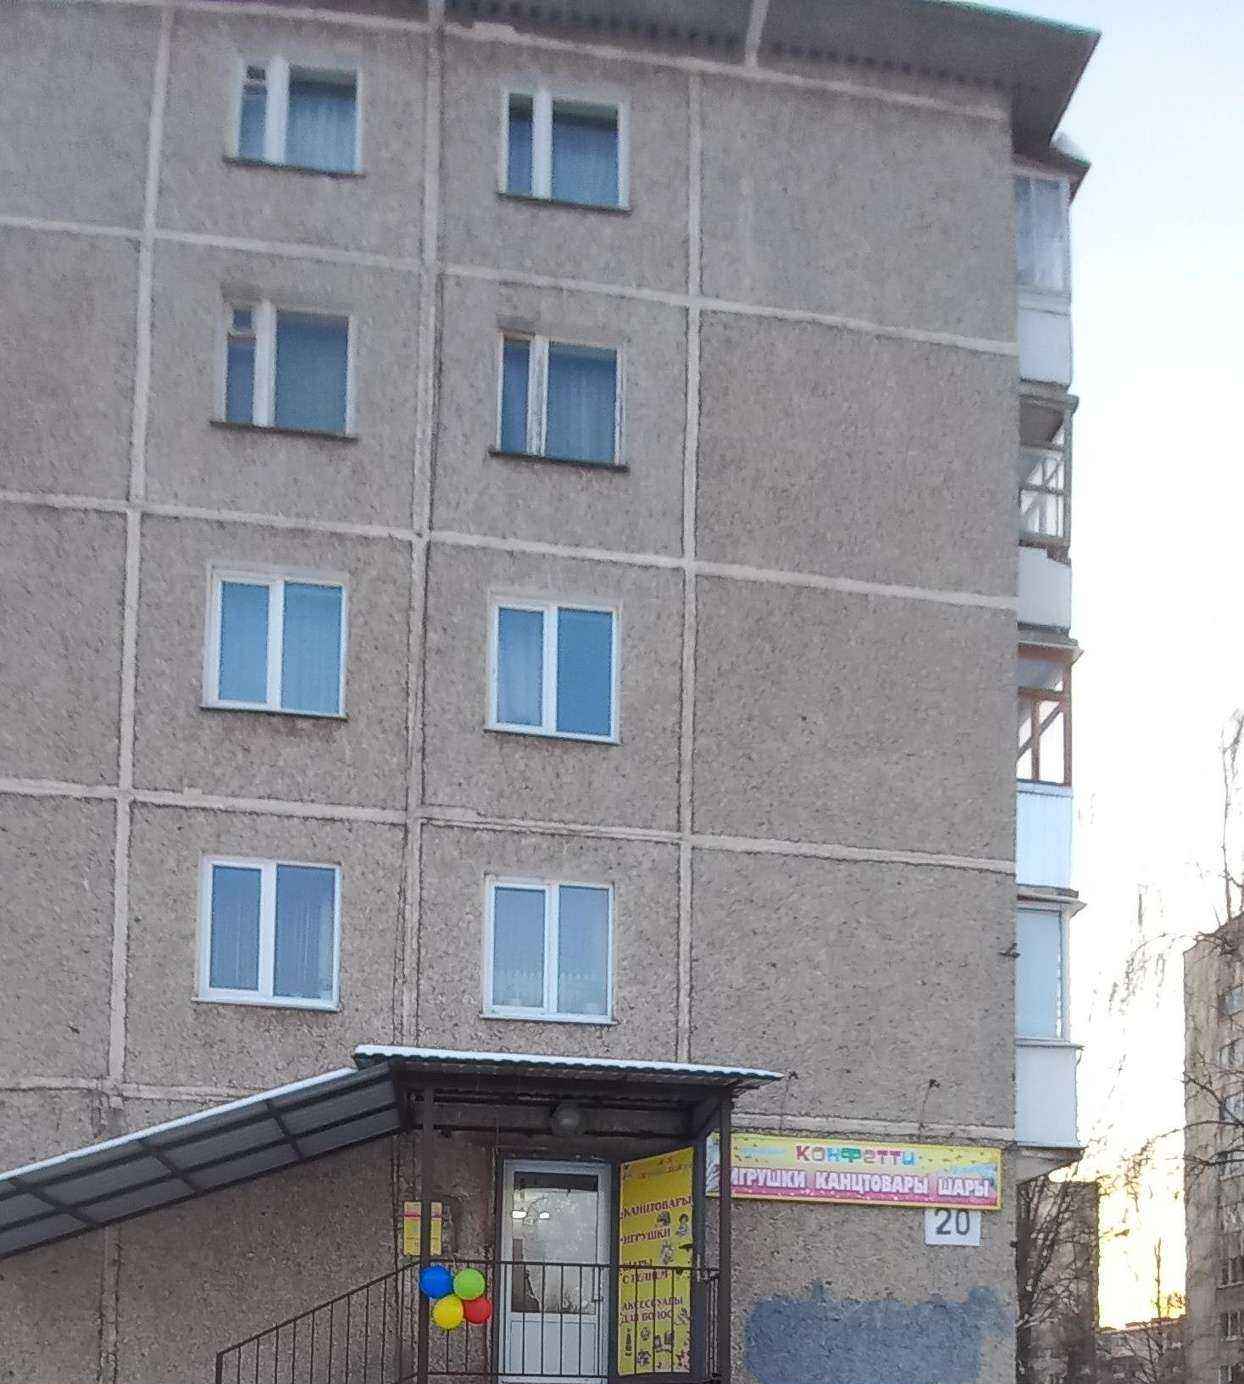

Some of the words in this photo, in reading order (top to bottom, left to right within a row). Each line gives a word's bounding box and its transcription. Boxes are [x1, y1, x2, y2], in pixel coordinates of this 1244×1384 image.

[815, 1171, 928, 1194] КАНЦТОВАРЫ
[938, 1178, 990, 1197] ШАРЫ
[935, 1209, 971, 1236] 20
